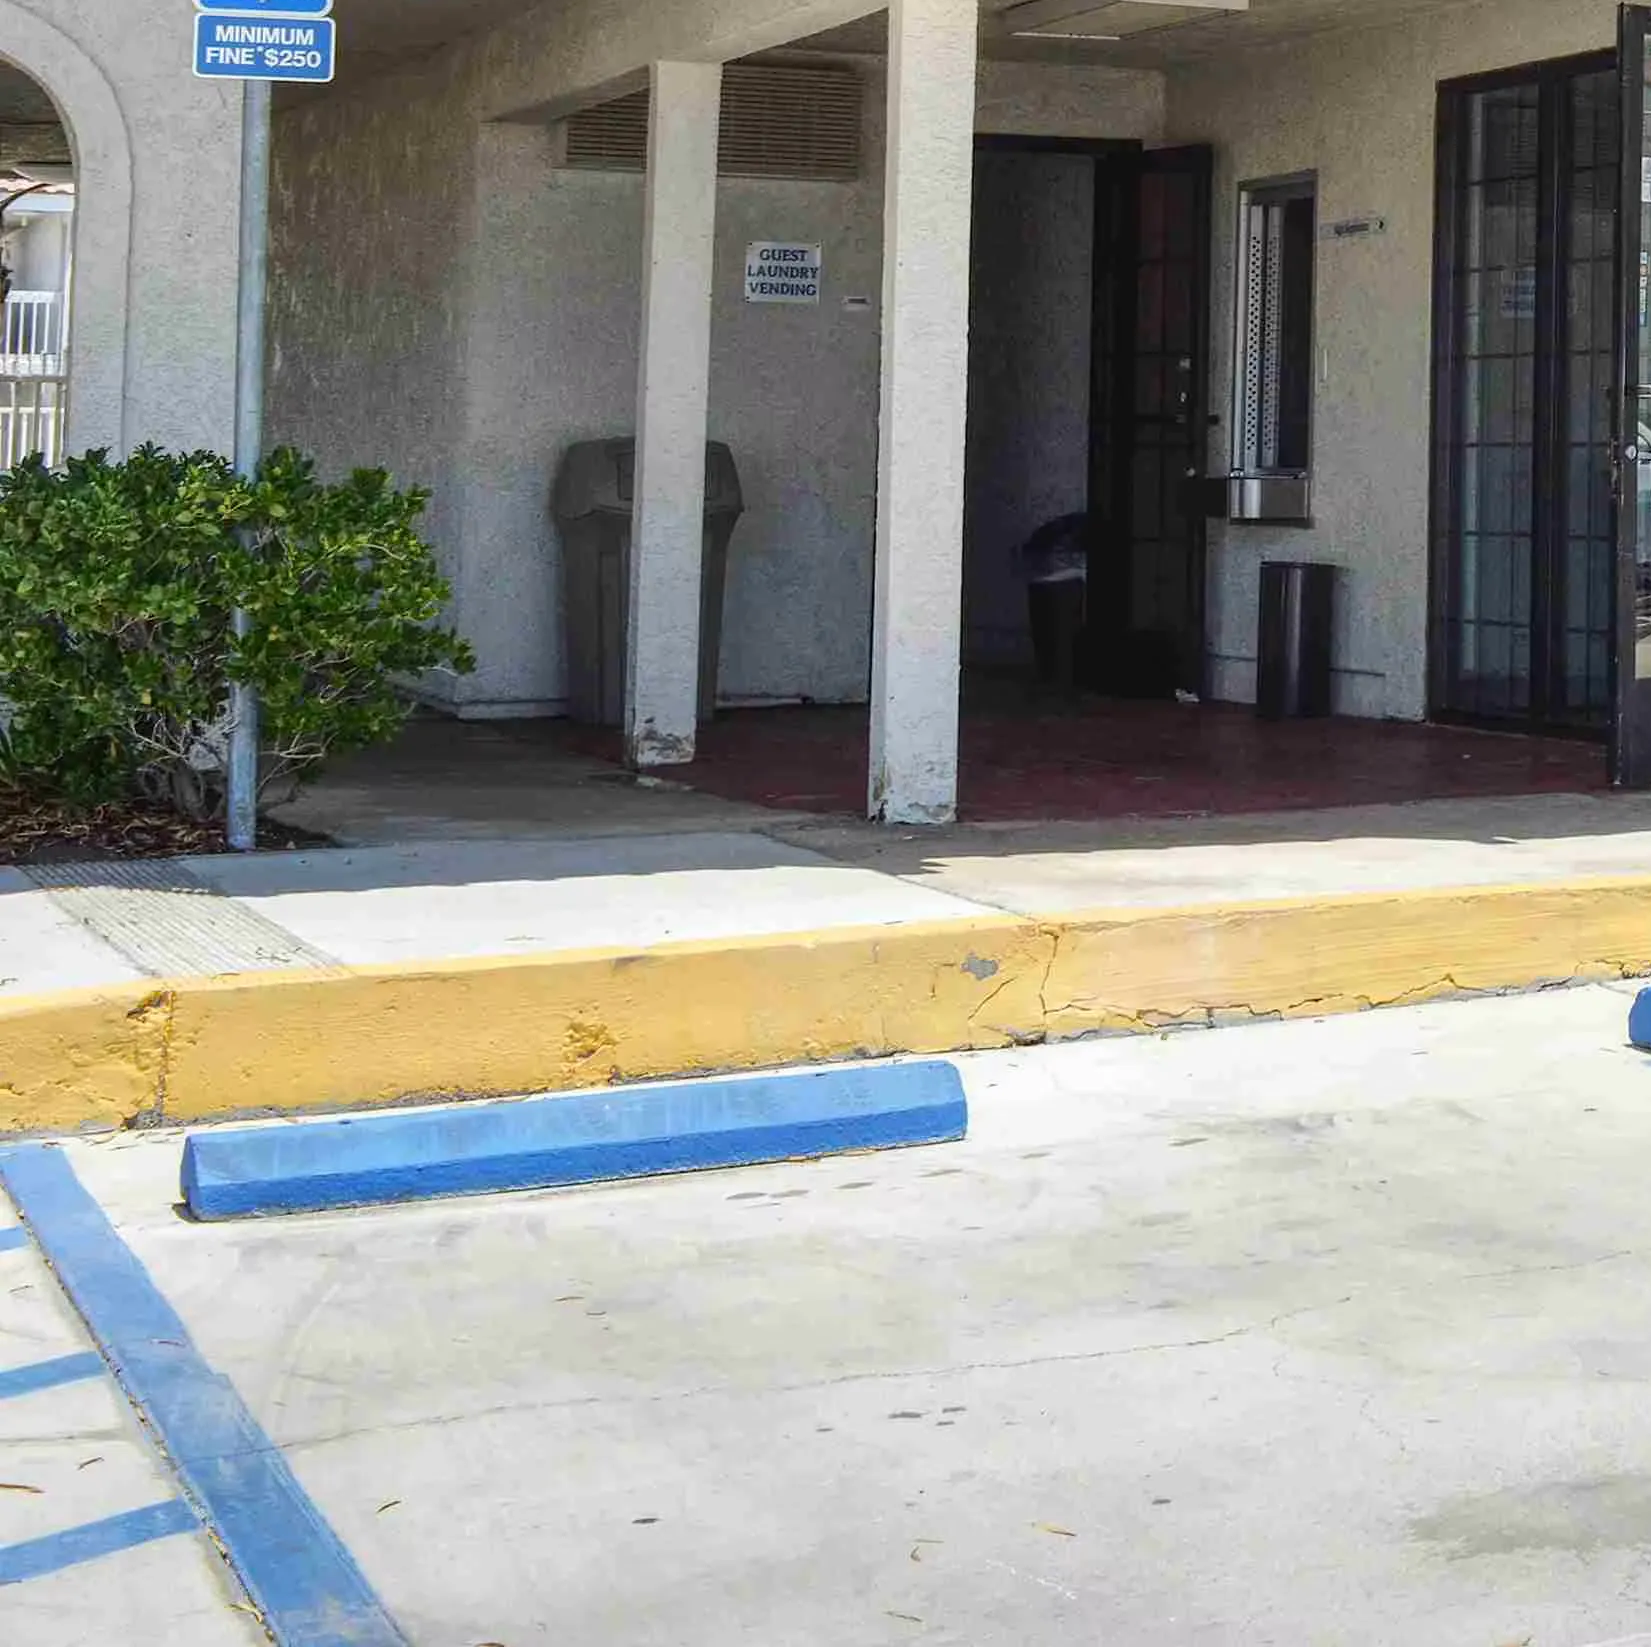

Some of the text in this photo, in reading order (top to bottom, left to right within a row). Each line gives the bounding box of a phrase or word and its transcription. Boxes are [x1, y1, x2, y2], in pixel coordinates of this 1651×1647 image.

[215, 24, 314, 46] MINIMUM
[205, 47, 322, 69] FINE $250
[760, 249, 808, 261] GUEST
[747, 264, 819, 279] LAUNDRY
[750, 282, 817, 296] VENDING
